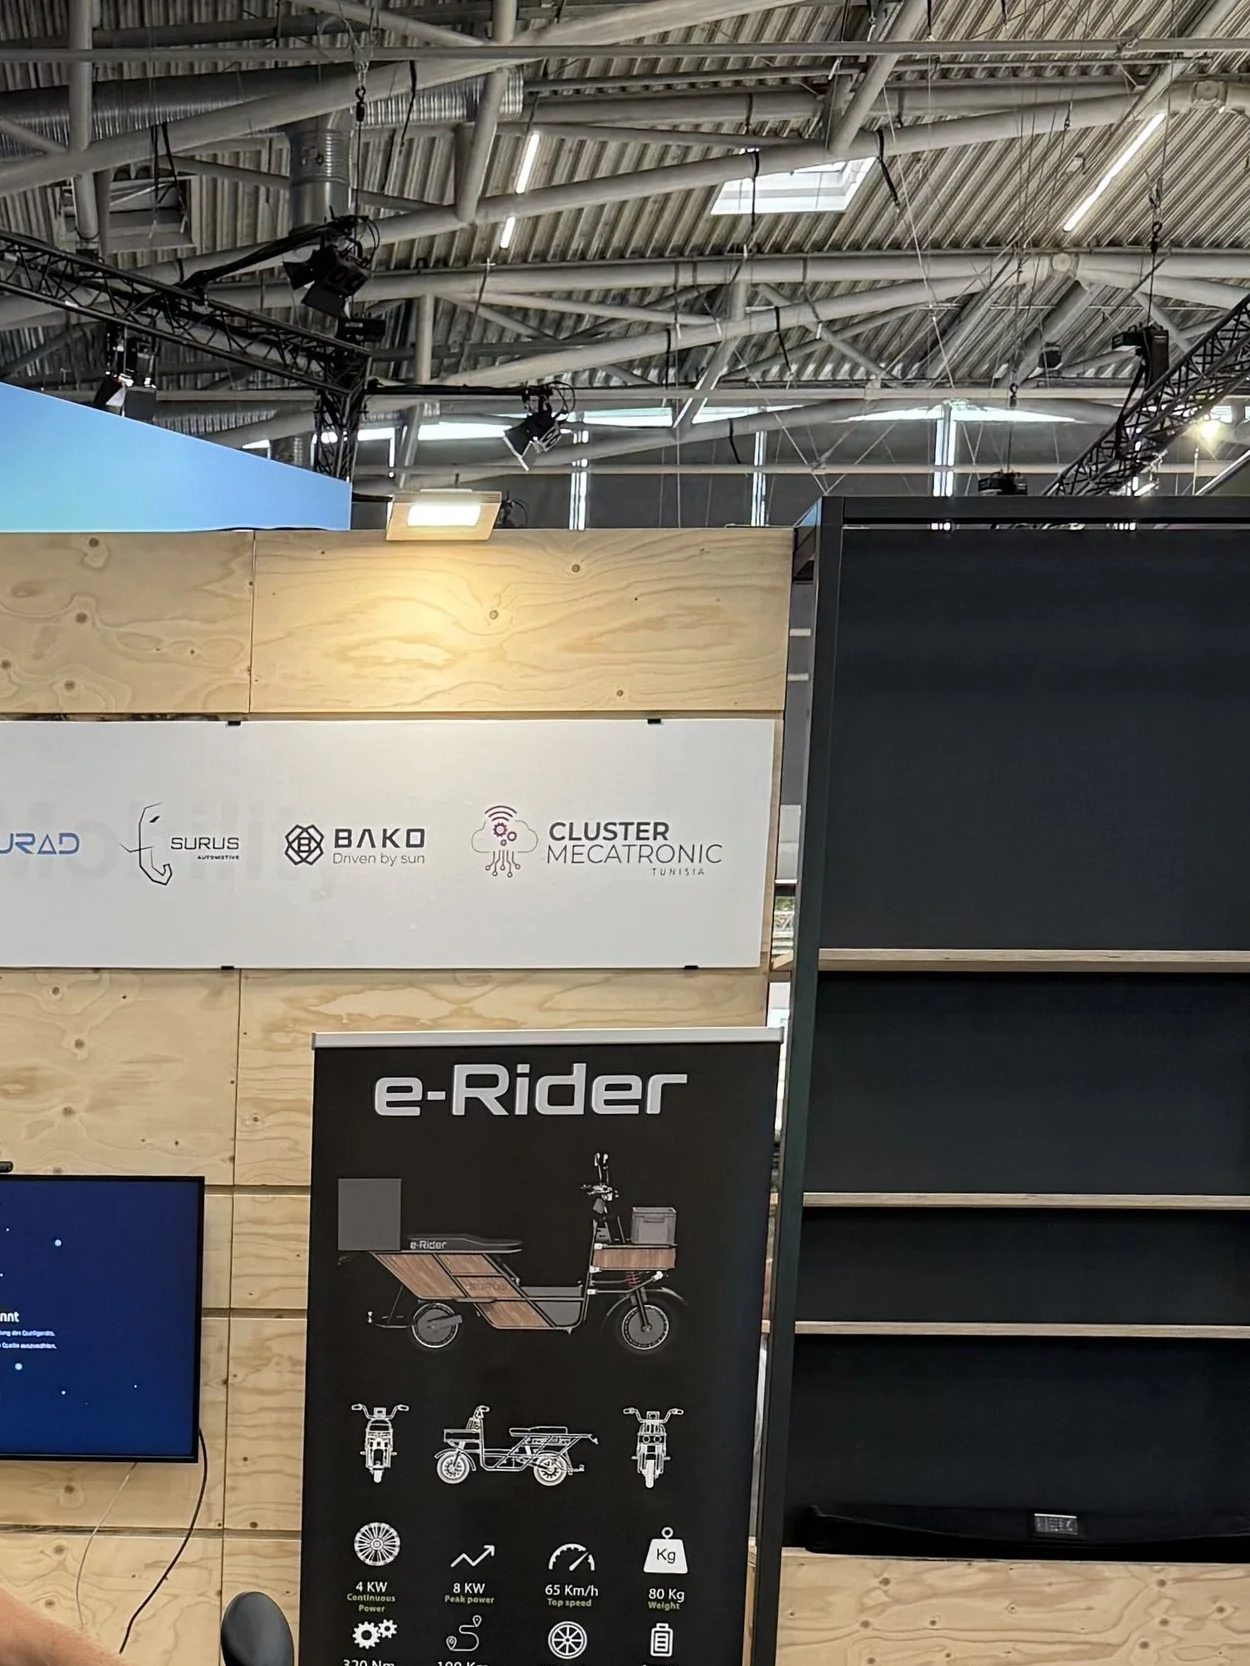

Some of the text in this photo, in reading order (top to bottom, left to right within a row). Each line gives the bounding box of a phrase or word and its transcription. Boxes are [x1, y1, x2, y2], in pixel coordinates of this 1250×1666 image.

[549, 821, 669, 842] CLUSTER
[170, 836, 240, 850] SURUS
[334, 827, 425, 849] BAKO
[332, 852, 425, 867] Driven by sun
[546, 844, 723, 865] MECATRONIC
[651, 867, 706, 876] TUNISIA
[373, 1063, 688, 1116] e-Rider
[409, 1239, 448, 1251] e-Rider
[656, 1548, 676, 1564] Kg
[356, 1581, 388, 1593] 4 KW
[453, 1583, 485, 1594] 8 KW
[545, 1584, 599, 1597] 65 Km/h
[347, 1593, 396, 1602] Continuous
[445, 1595, 495, 1605] Peak power
[648, 1588, 685, 1603] 80 Kg
[359, 1605, 385, 1613] Power
[547, 1598, 592, 1608] Top speed
[648, 1601, 680, 1611] Weight
